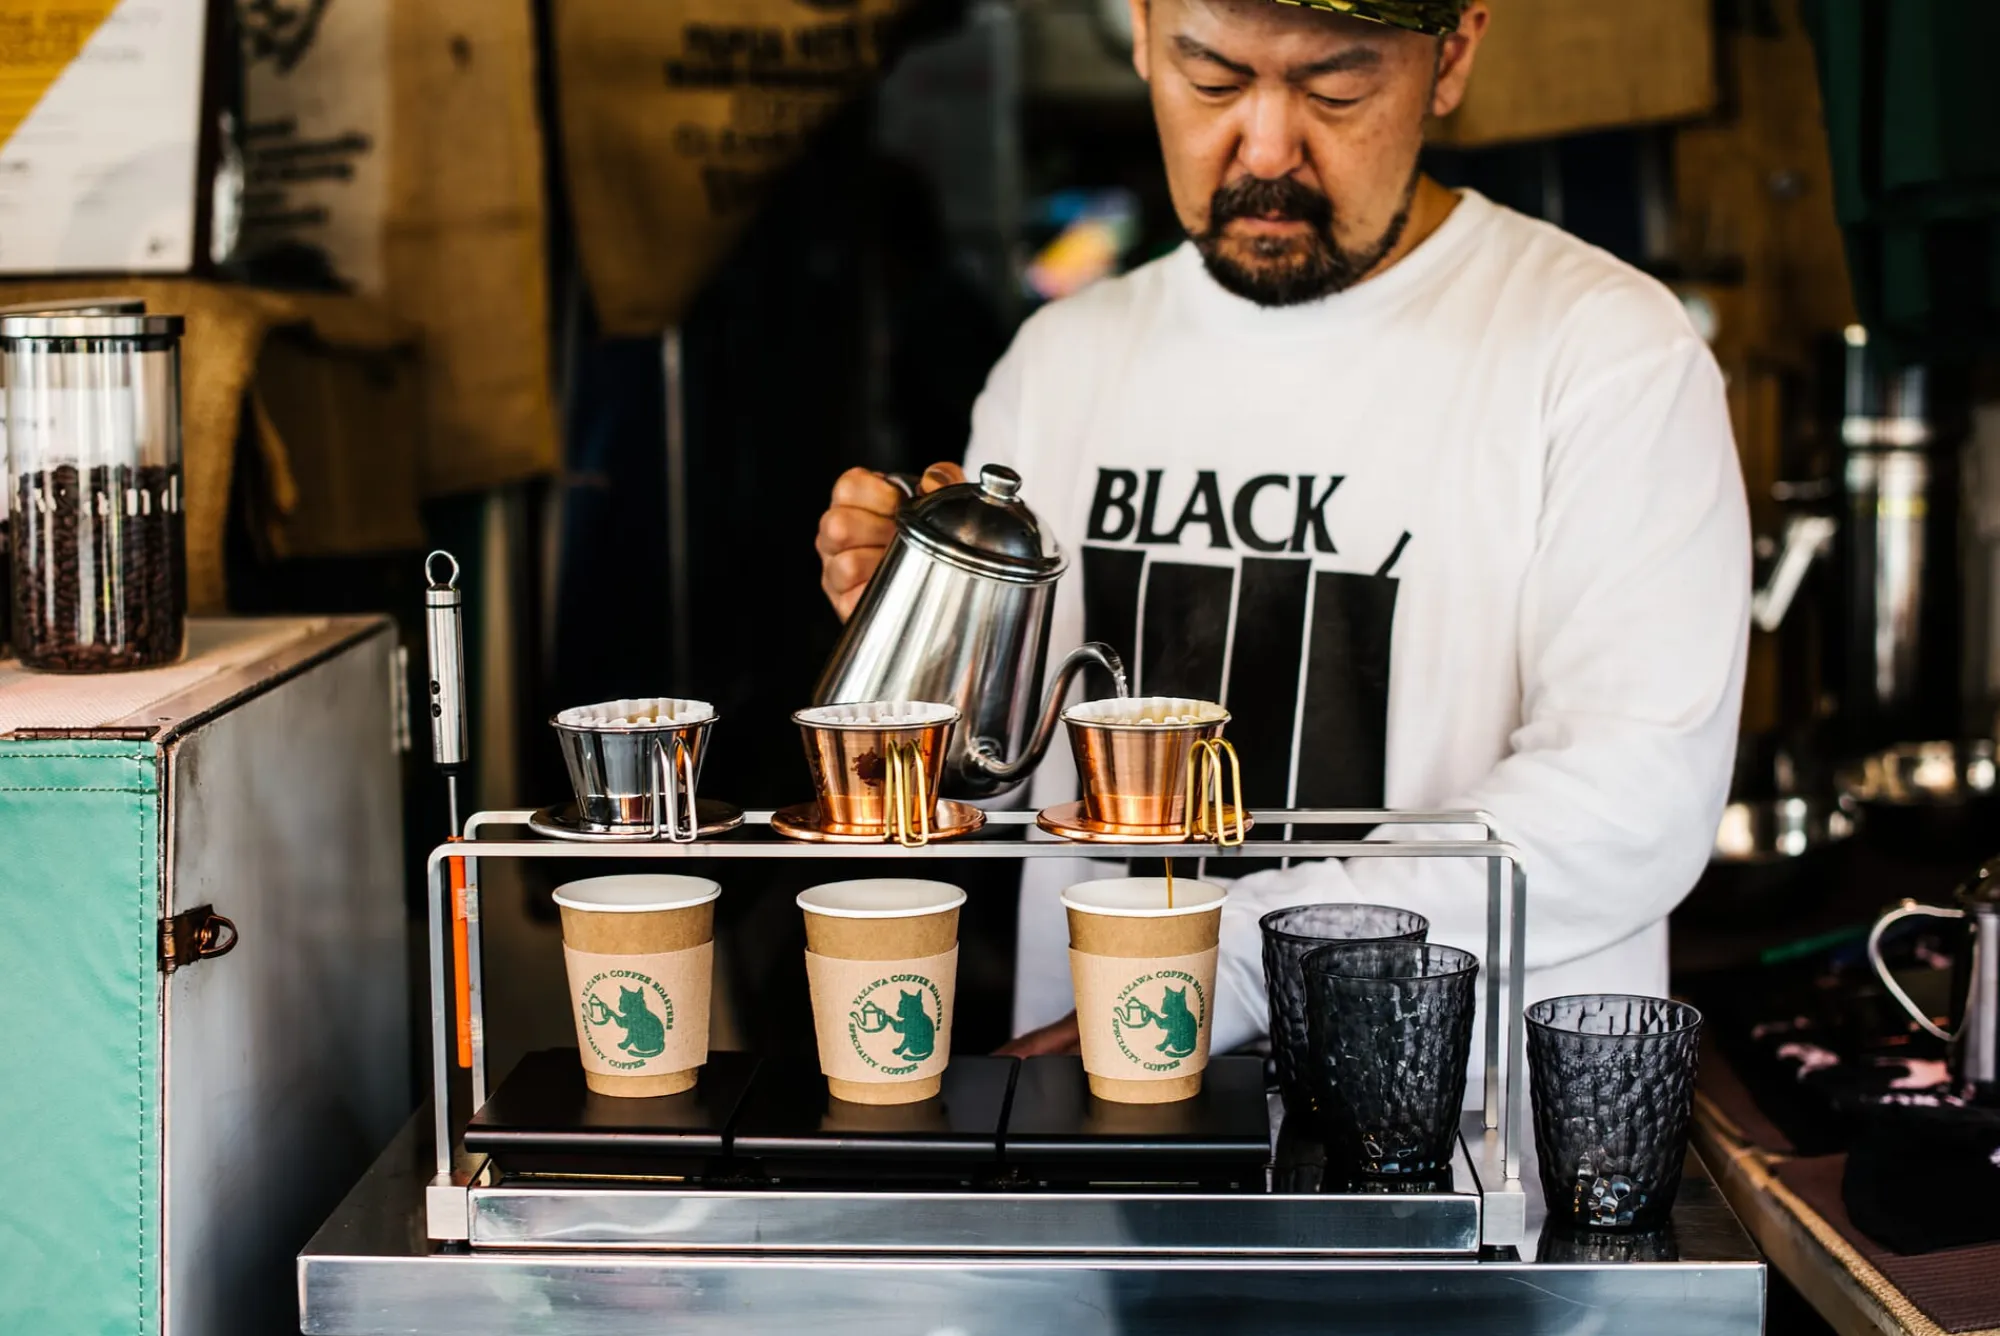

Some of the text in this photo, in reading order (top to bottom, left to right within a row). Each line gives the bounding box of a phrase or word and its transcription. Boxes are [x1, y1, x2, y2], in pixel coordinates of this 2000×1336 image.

[1086, 466, 1346, 554] BLACK
[609, 970, 652, 985] COFFEE
[652, 981, 675, 1031] ROASTERS
[852, 974, 943, 1032] YAZAWA COFFEE ROASTERS
[1117, 974, 1153, 1001] YAZAWA
[1156, 970, 1194, 984] COFFEE
[581, 1014, 646, 1070] SPECIALTY COFFEE
[848, 1022, 919, 1075] SPECIALTY COFFEE
[1112, 1018, 1180, 1072] SPECIALTY COFFEE
